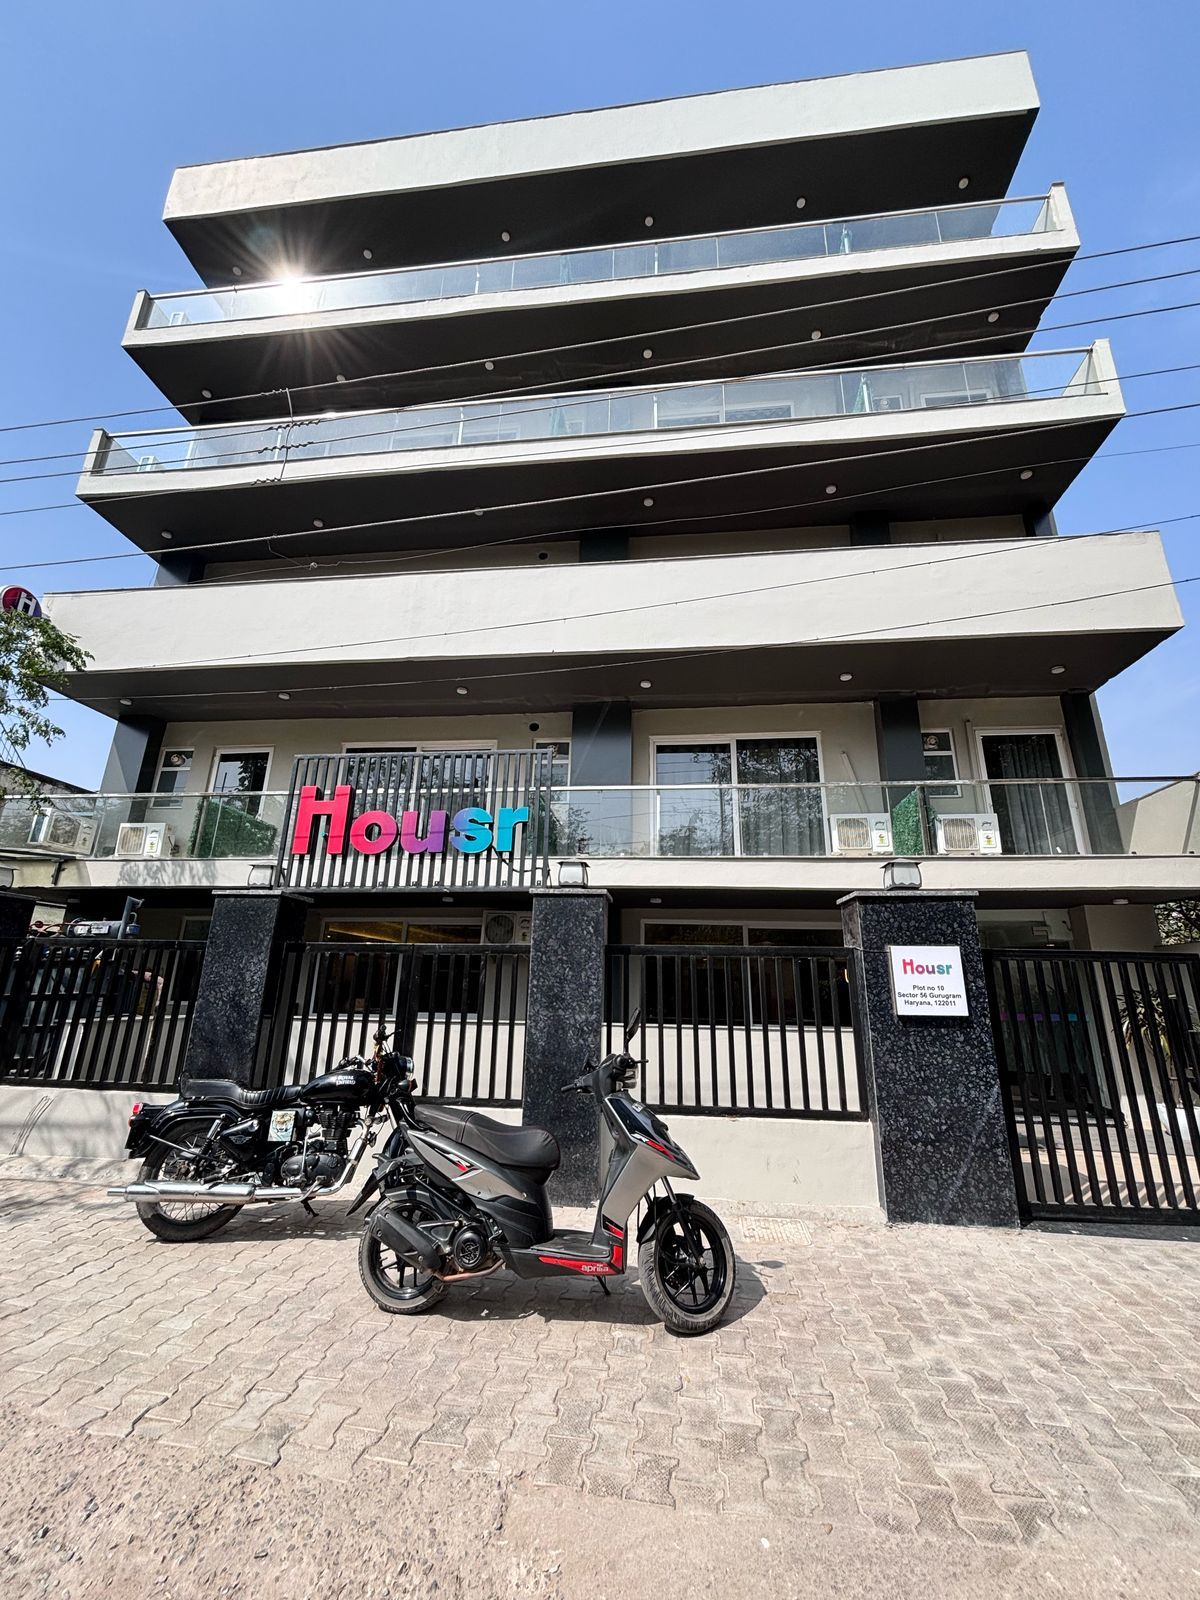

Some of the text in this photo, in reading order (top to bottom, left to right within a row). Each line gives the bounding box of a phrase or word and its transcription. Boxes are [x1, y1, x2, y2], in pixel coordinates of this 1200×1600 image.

[292, 785, 529, 855] Housr
[902, 958, 953, 975] Housr
[897, 991, 918, 999] Sector
[928, 992, 962, 1000] Gurugram
[904, 999, 933, 1007] Haryana,
